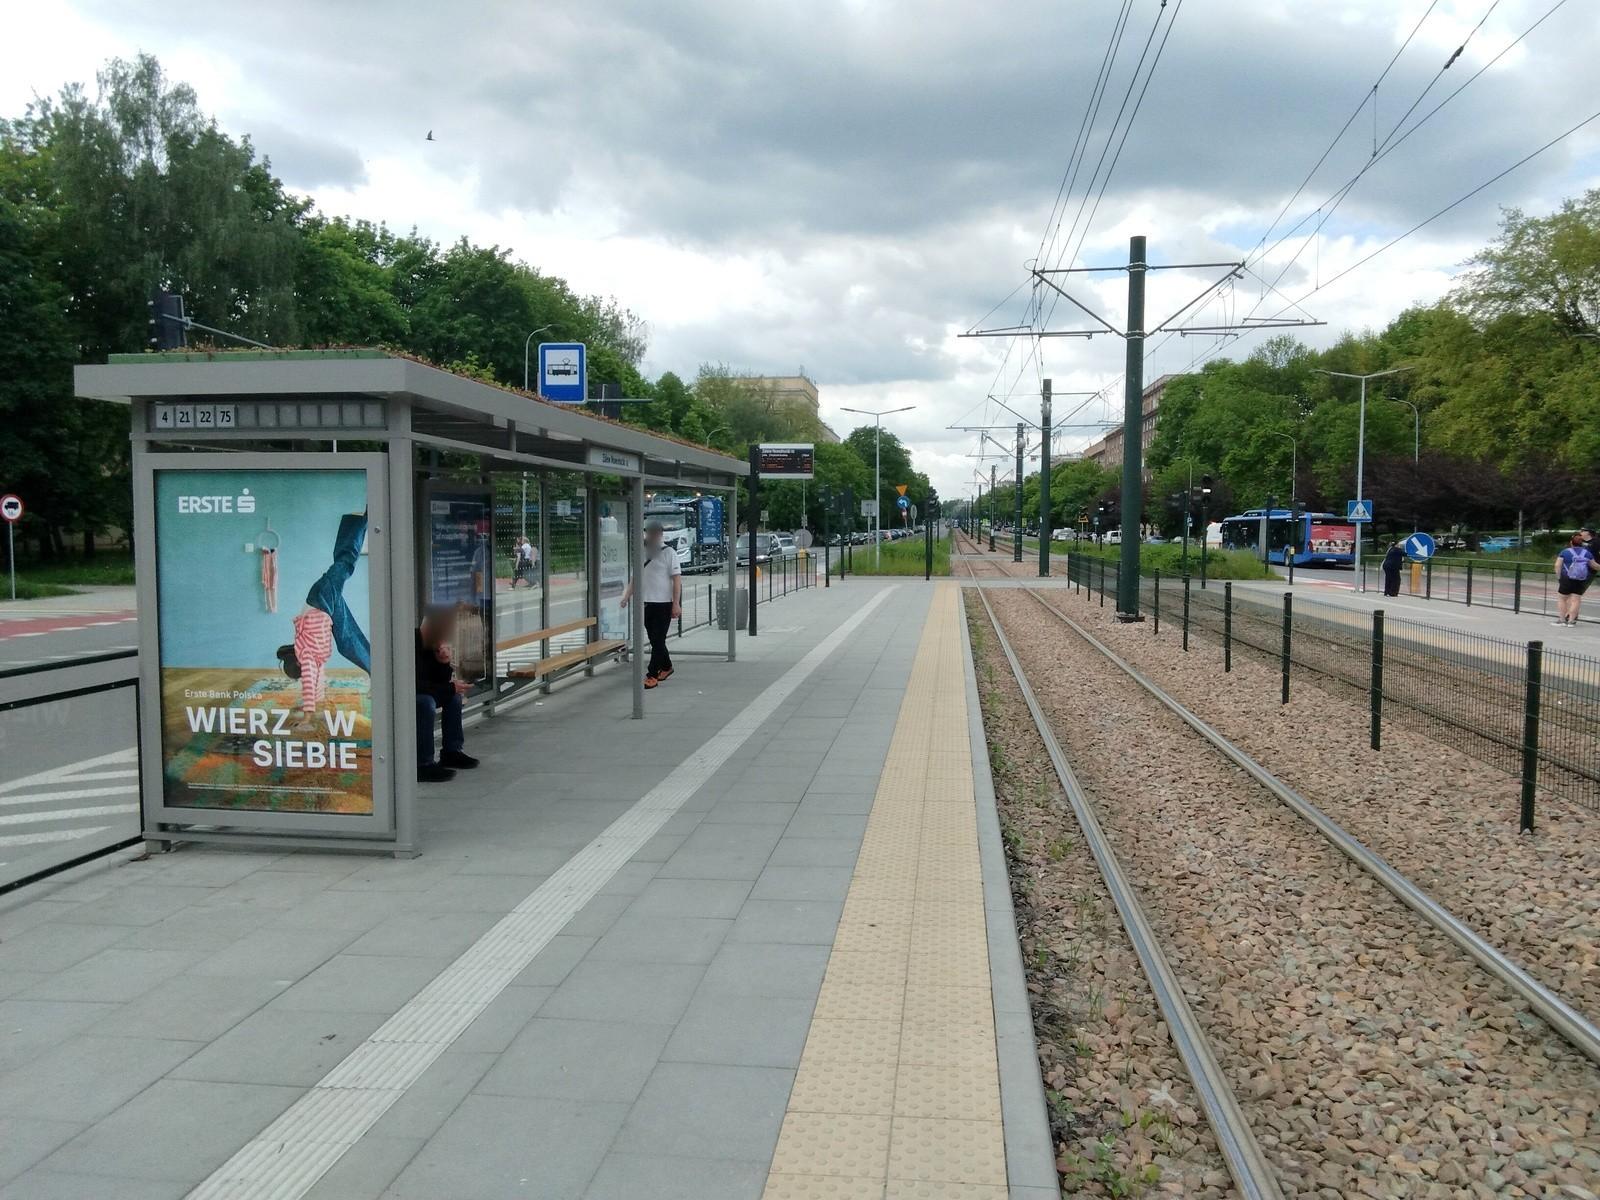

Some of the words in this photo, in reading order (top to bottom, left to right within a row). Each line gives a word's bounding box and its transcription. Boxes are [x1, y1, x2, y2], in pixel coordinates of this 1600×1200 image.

[162, 411, 168, 423] 4
[179, 411, 191, 423] 21
[200, 411, 211, 423] 22
[220, 410, 231, 423] 75
[178, 495, 233, 513] ERSTE
[184, 689, 207, 698] Erste
[209, 689, 232, 699] Bank
[233, 690, 263, 700] Polska
[186, 706, 291, 735] WIERZ
[324, 710, 357, 737] W
[253, 740, 358, 769] SIEBIE
